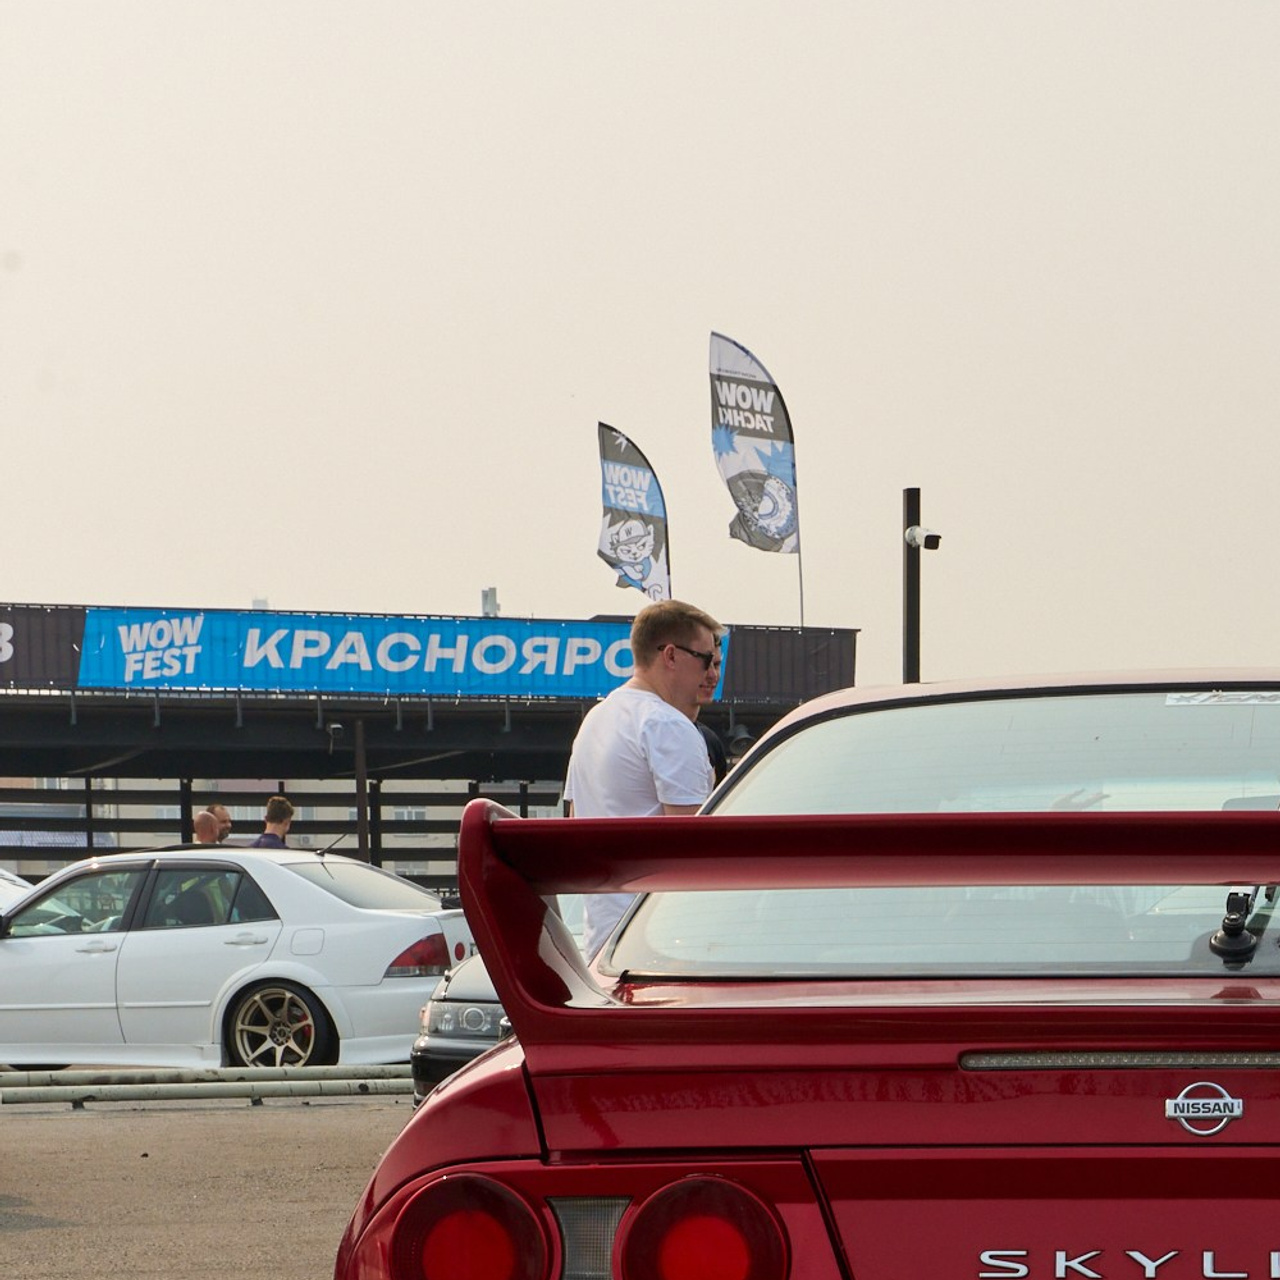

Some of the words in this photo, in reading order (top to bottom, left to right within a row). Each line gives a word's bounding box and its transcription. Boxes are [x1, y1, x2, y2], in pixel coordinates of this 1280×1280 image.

[117, 615, 205, 653] WOW
[242, 627, 635, 678] КРАСНОЯРС
[124, 645, 203, 683] FEST
[1173, 1102, 1235, 1115] NISSAN
